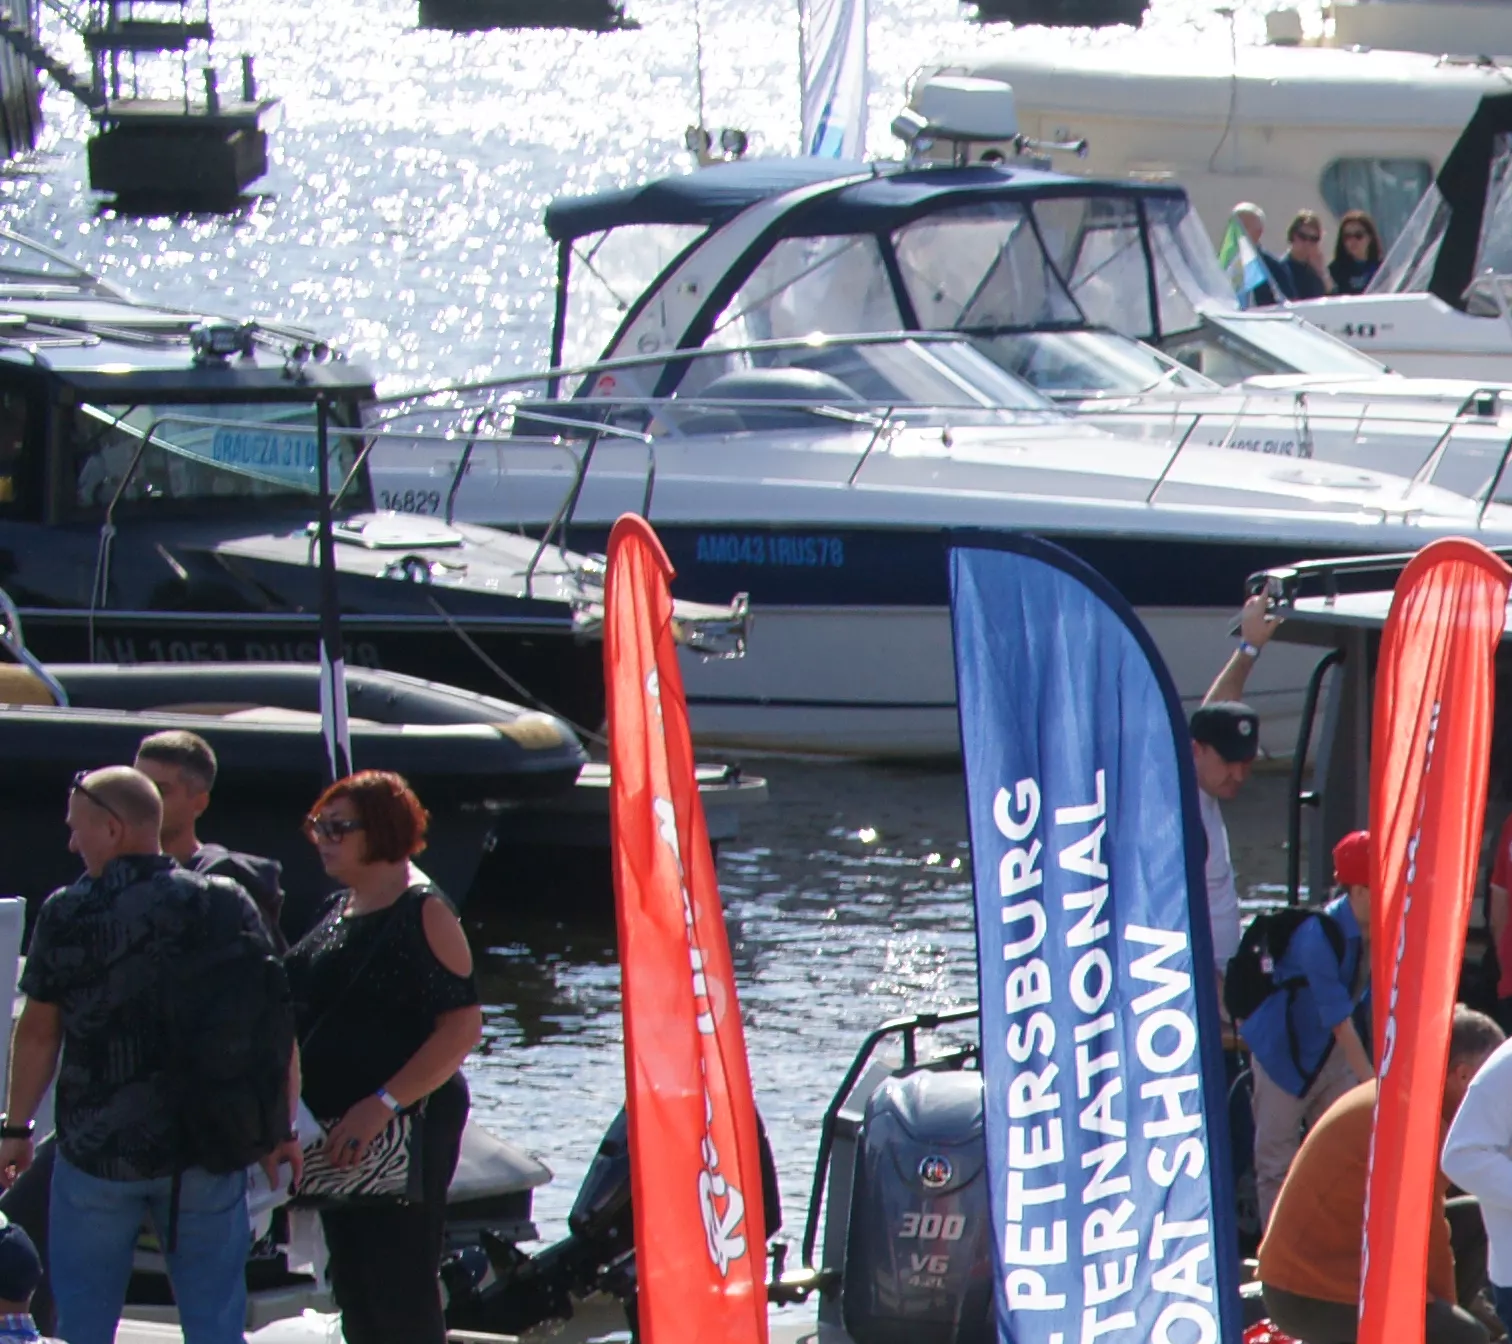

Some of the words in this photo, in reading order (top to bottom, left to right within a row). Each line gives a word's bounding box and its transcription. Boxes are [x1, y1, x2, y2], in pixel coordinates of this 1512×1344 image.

[993, 777, 1068, 1311] PETERSBURG
[1124, 923, 1208, 1182] SHOW
[899, 1212, 967, 1241] 300
[910, 1253, 950, 1275] V6
